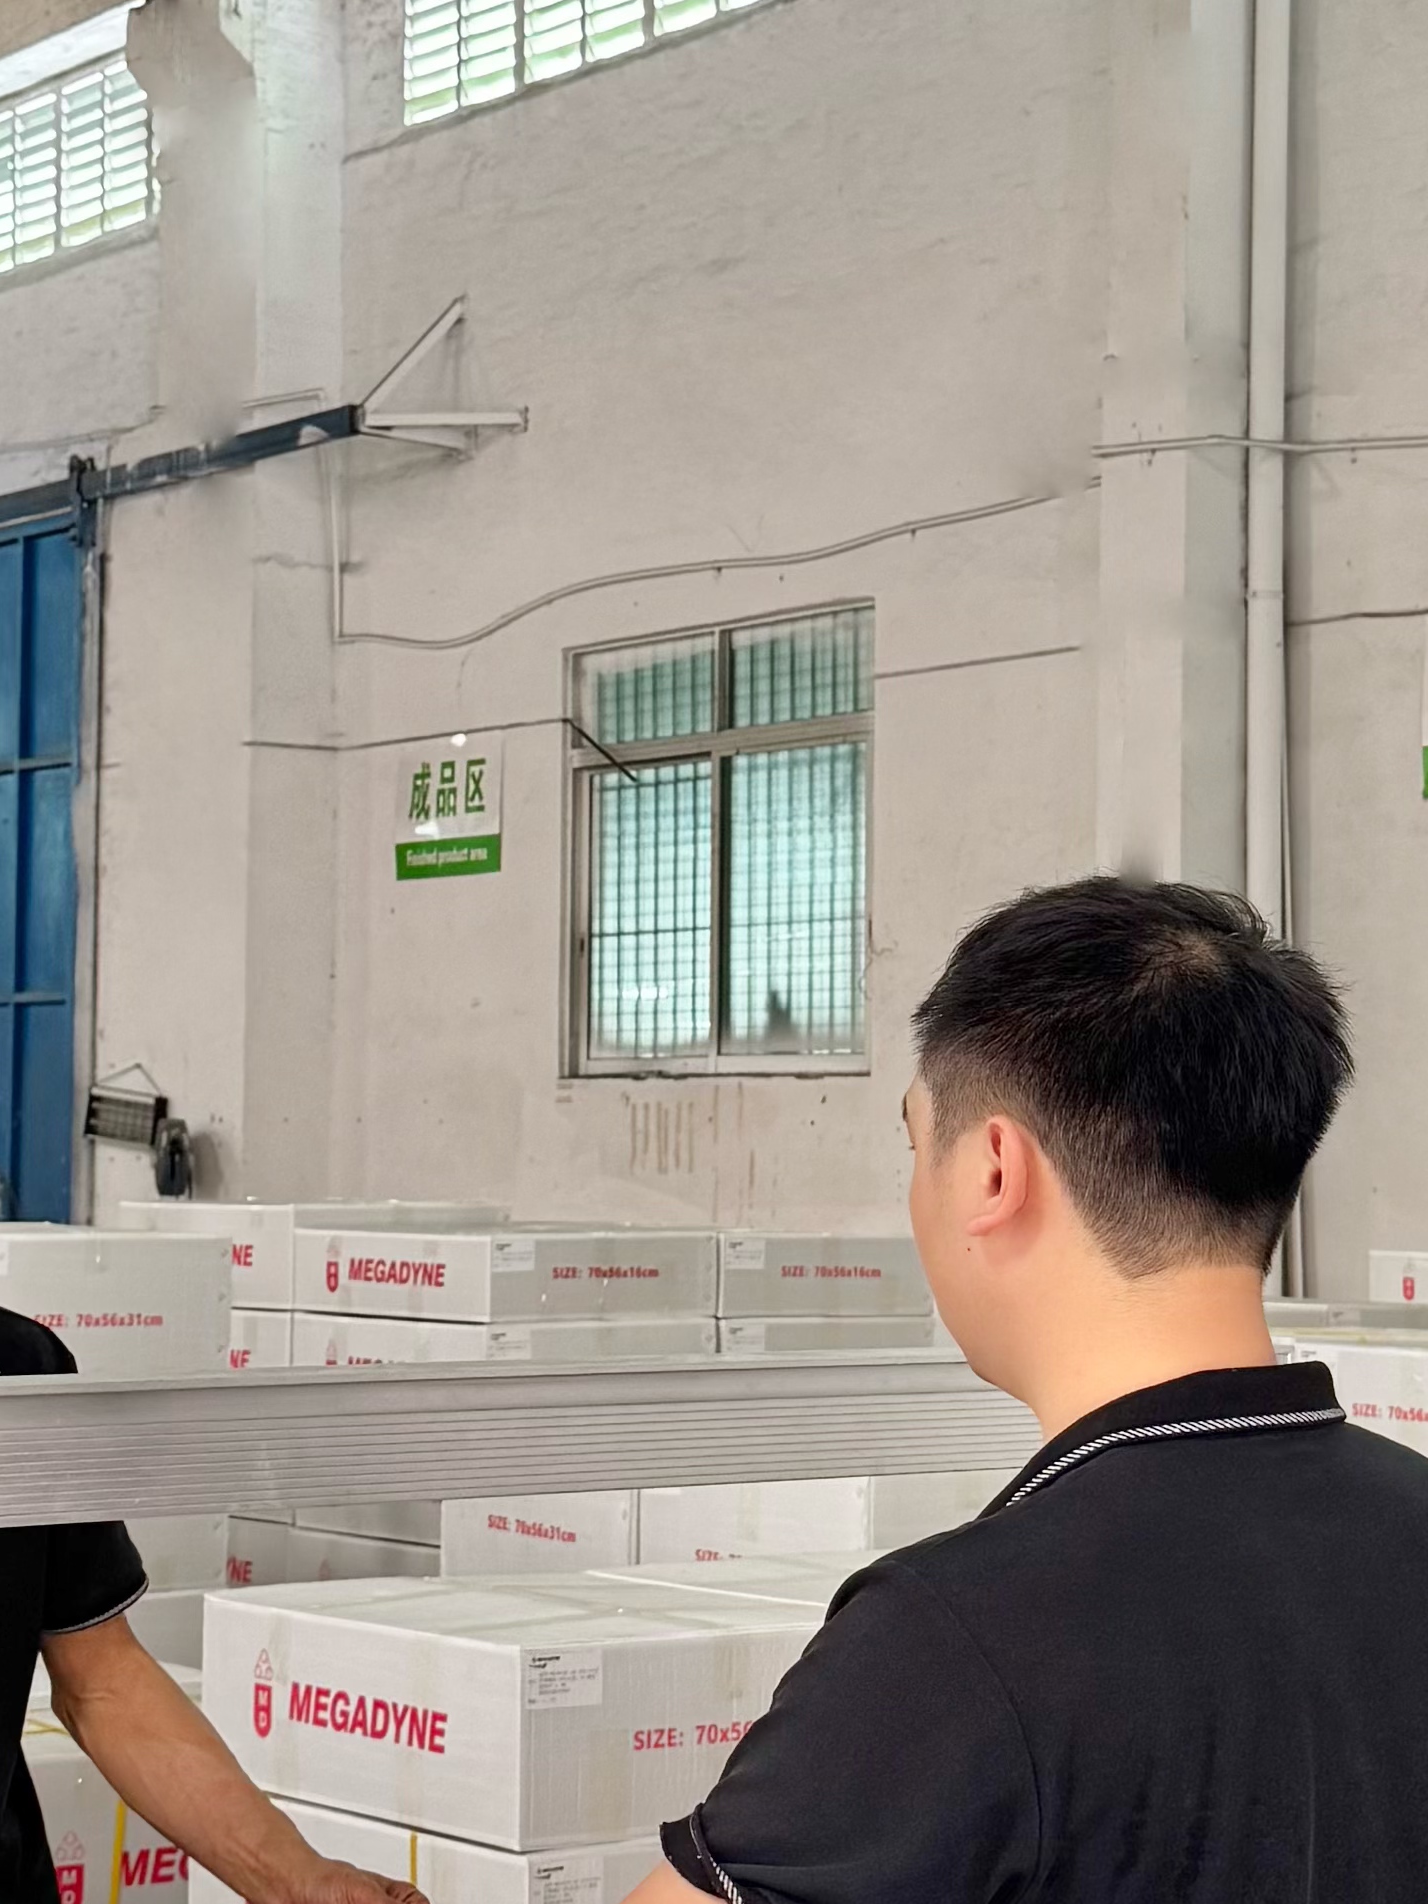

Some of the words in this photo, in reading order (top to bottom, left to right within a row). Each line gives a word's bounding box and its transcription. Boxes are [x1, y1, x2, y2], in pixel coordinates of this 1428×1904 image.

[408, 758, 486, 821] 成品区
[348, 1257, 446, 1288] MEGADYNE
[1352, 1403, 1382, 1419] SIZE:
[288, 1681, 449, 1756] MEGADYNE
[633, 1727, 684, 1751] SIZE:
